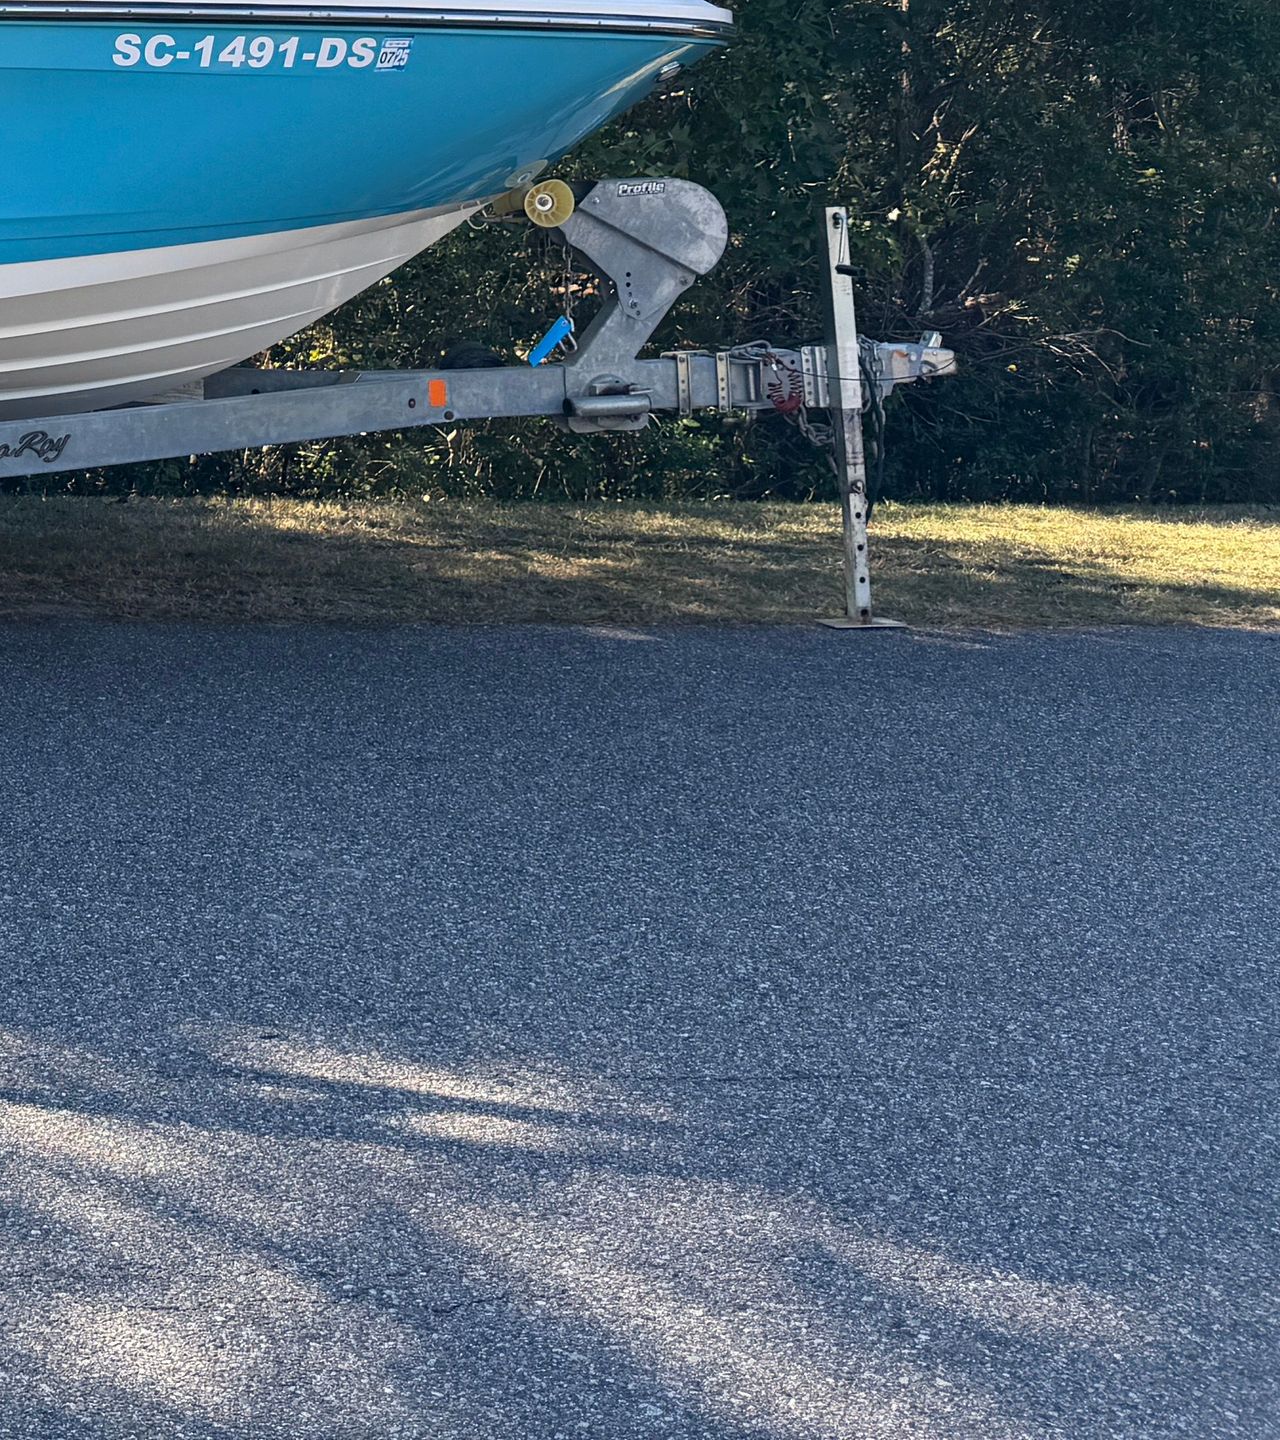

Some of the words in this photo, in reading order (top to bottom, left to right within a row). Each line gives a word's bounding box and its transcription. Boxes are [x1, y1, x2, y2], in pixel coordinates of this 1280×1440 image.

[112, 33, 377, 68] SC-1491-DS
[618, 182, 665, 194] Profile
[13, 430, 71, 463] Ray
